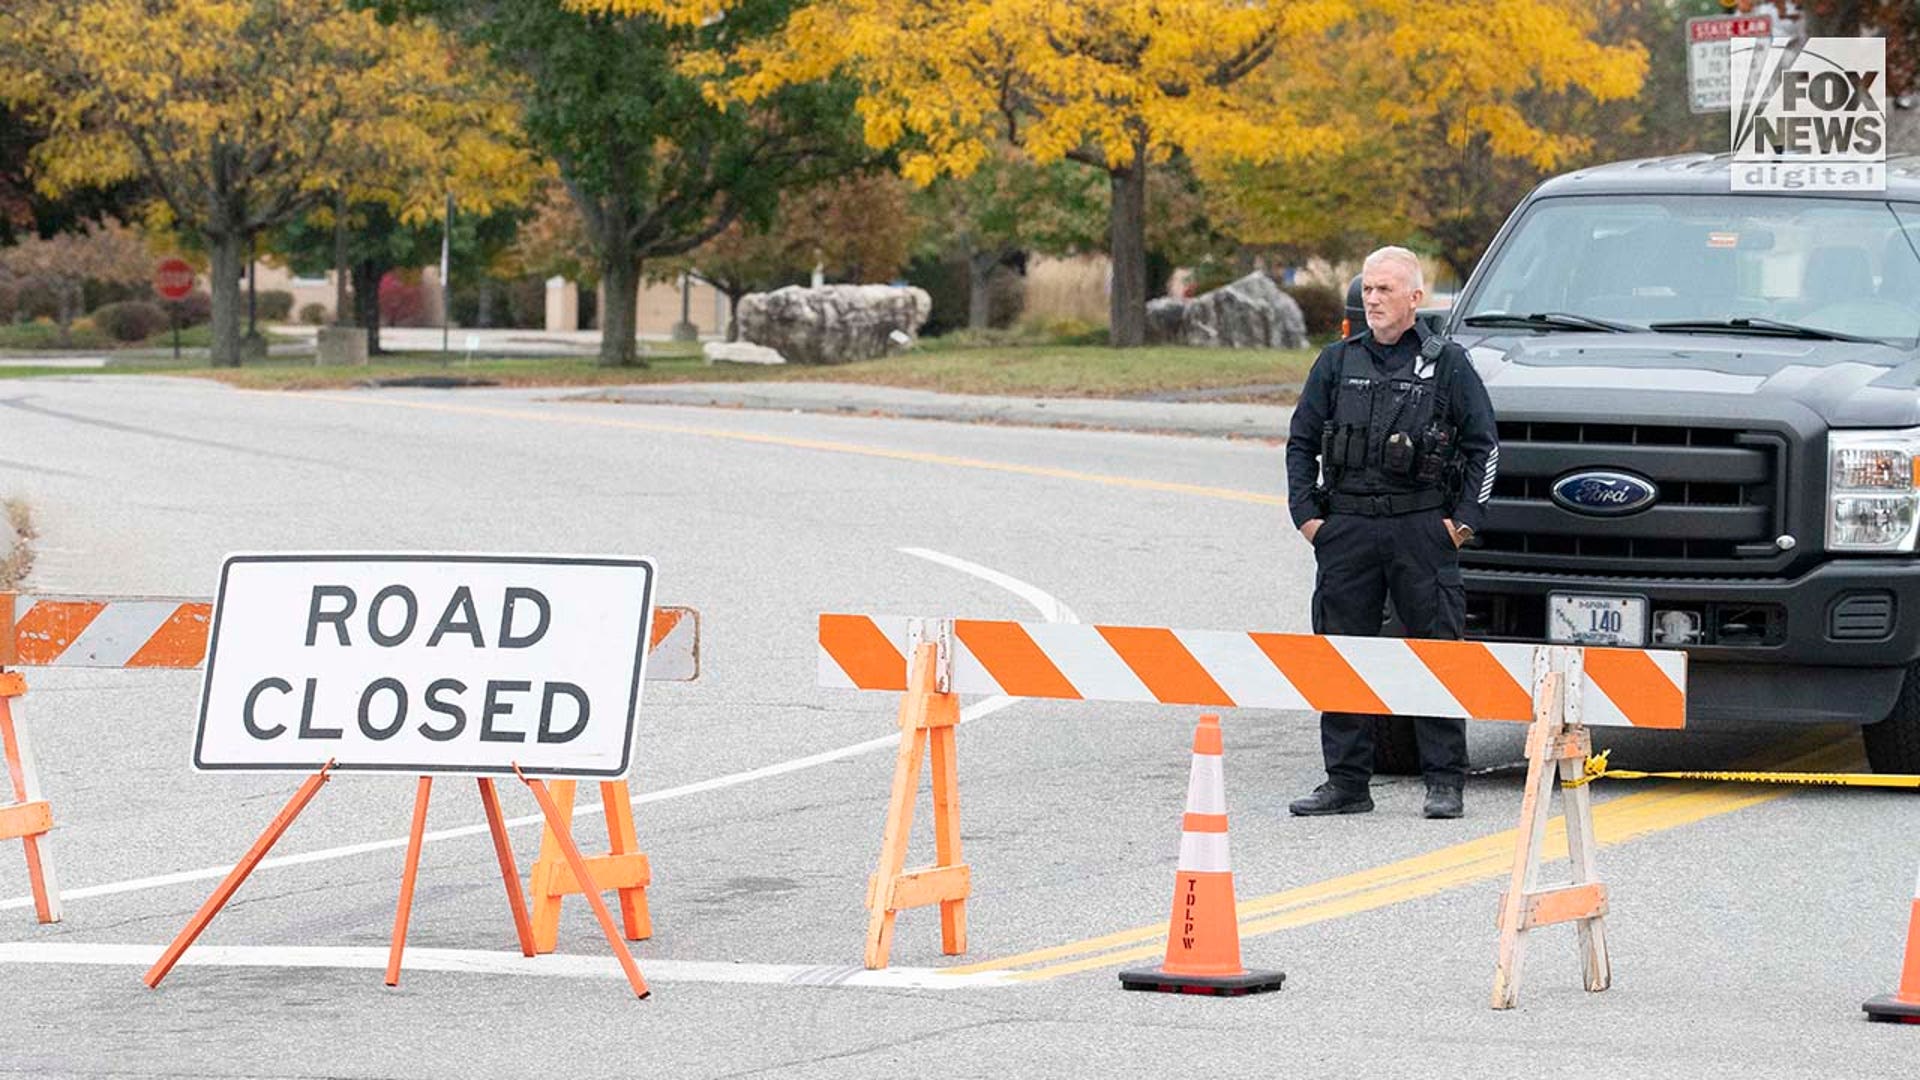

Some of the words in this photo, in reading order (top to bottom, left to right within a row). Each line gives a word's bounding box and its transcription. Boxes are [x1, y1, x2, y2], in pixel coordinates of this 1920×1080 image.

[1695, 22, 1731, 38] STATE
[1738, 20, 1767, 35] LAW
[1576, 478, 1630, 502] Ford
[304, 584, 552, 648] ROAD
[1590, 610, 1621, 632] 140
[243, 677, 590, 743] CLOSED
[1182, 880, 1197, 950] TDLPW
